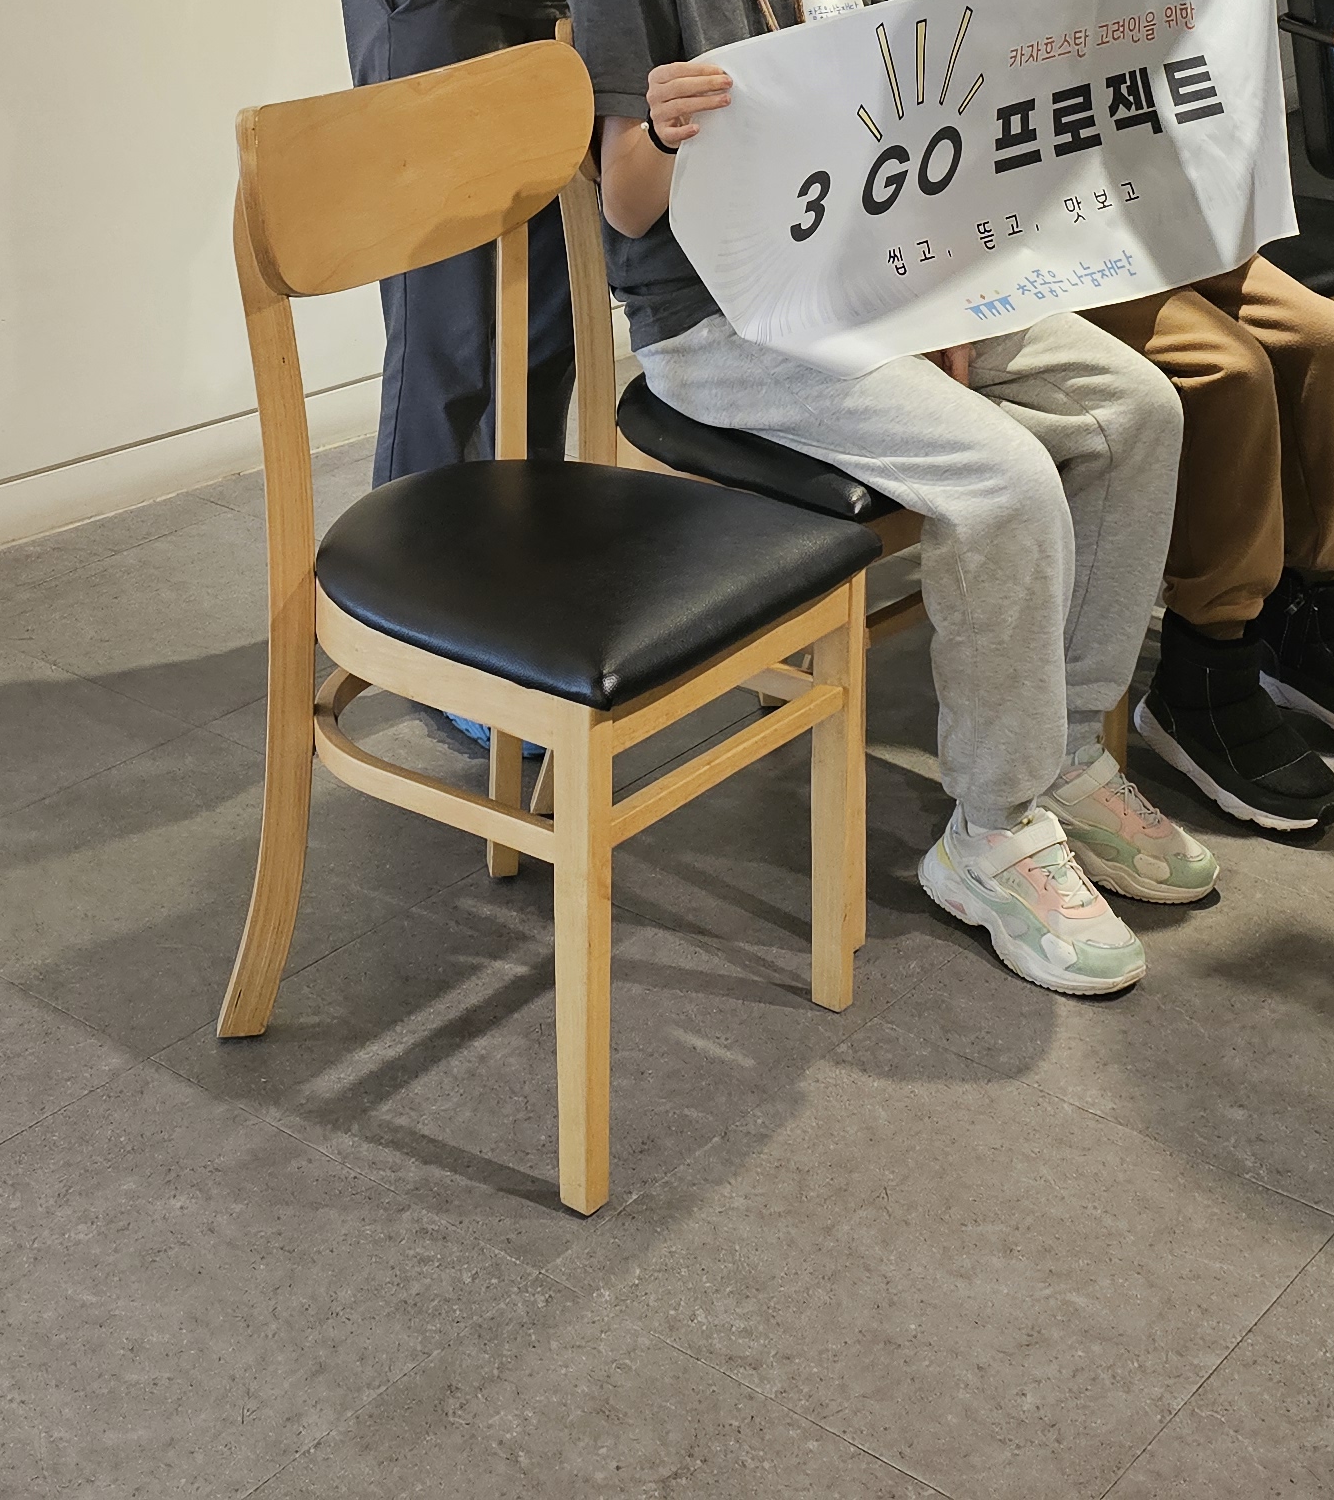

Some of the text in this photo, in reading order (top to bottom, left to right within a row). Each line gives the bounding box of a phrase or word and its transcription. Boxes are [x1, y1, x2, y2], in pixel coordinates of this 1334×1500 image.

[1009, 1, 1196, 68] 카자흐스탄 고려인을 위한
[790, 55, 1224, 242] 3 GO 프로젝트
[1017, 250, 1137, 299] 참좋은나눔재단
